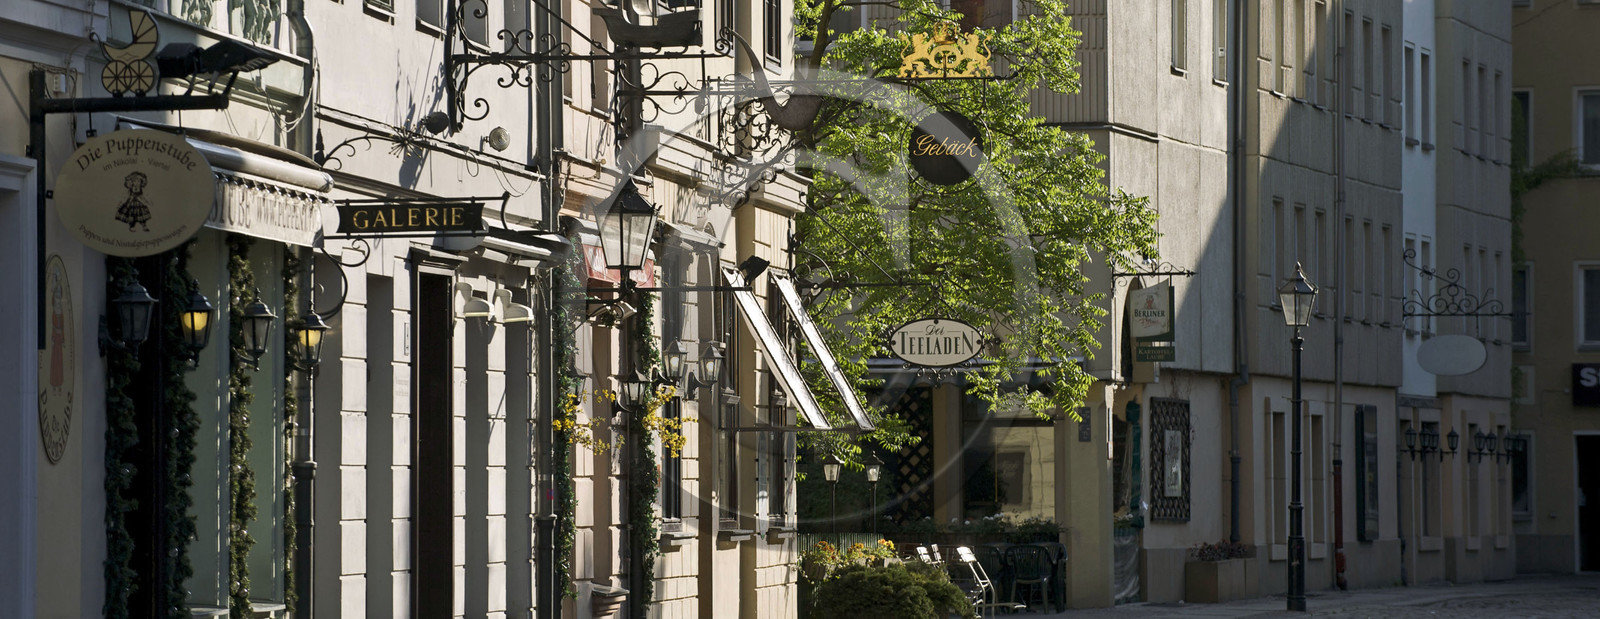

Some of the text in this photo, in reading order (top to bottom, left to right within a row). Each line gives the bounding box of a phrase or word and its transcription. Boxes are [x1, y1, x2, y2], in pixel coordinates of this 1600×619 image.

[76, 137, 197, 172] Die Puppenstube
[913, 134, 978, 158] Gebäck
[352, 207, 465, 230] GALERIE
[1134, 309, 1165, 318] BERLINER
[925, 324, 946, 336] Der
[898, 330, 975, 355] TEELADEN
